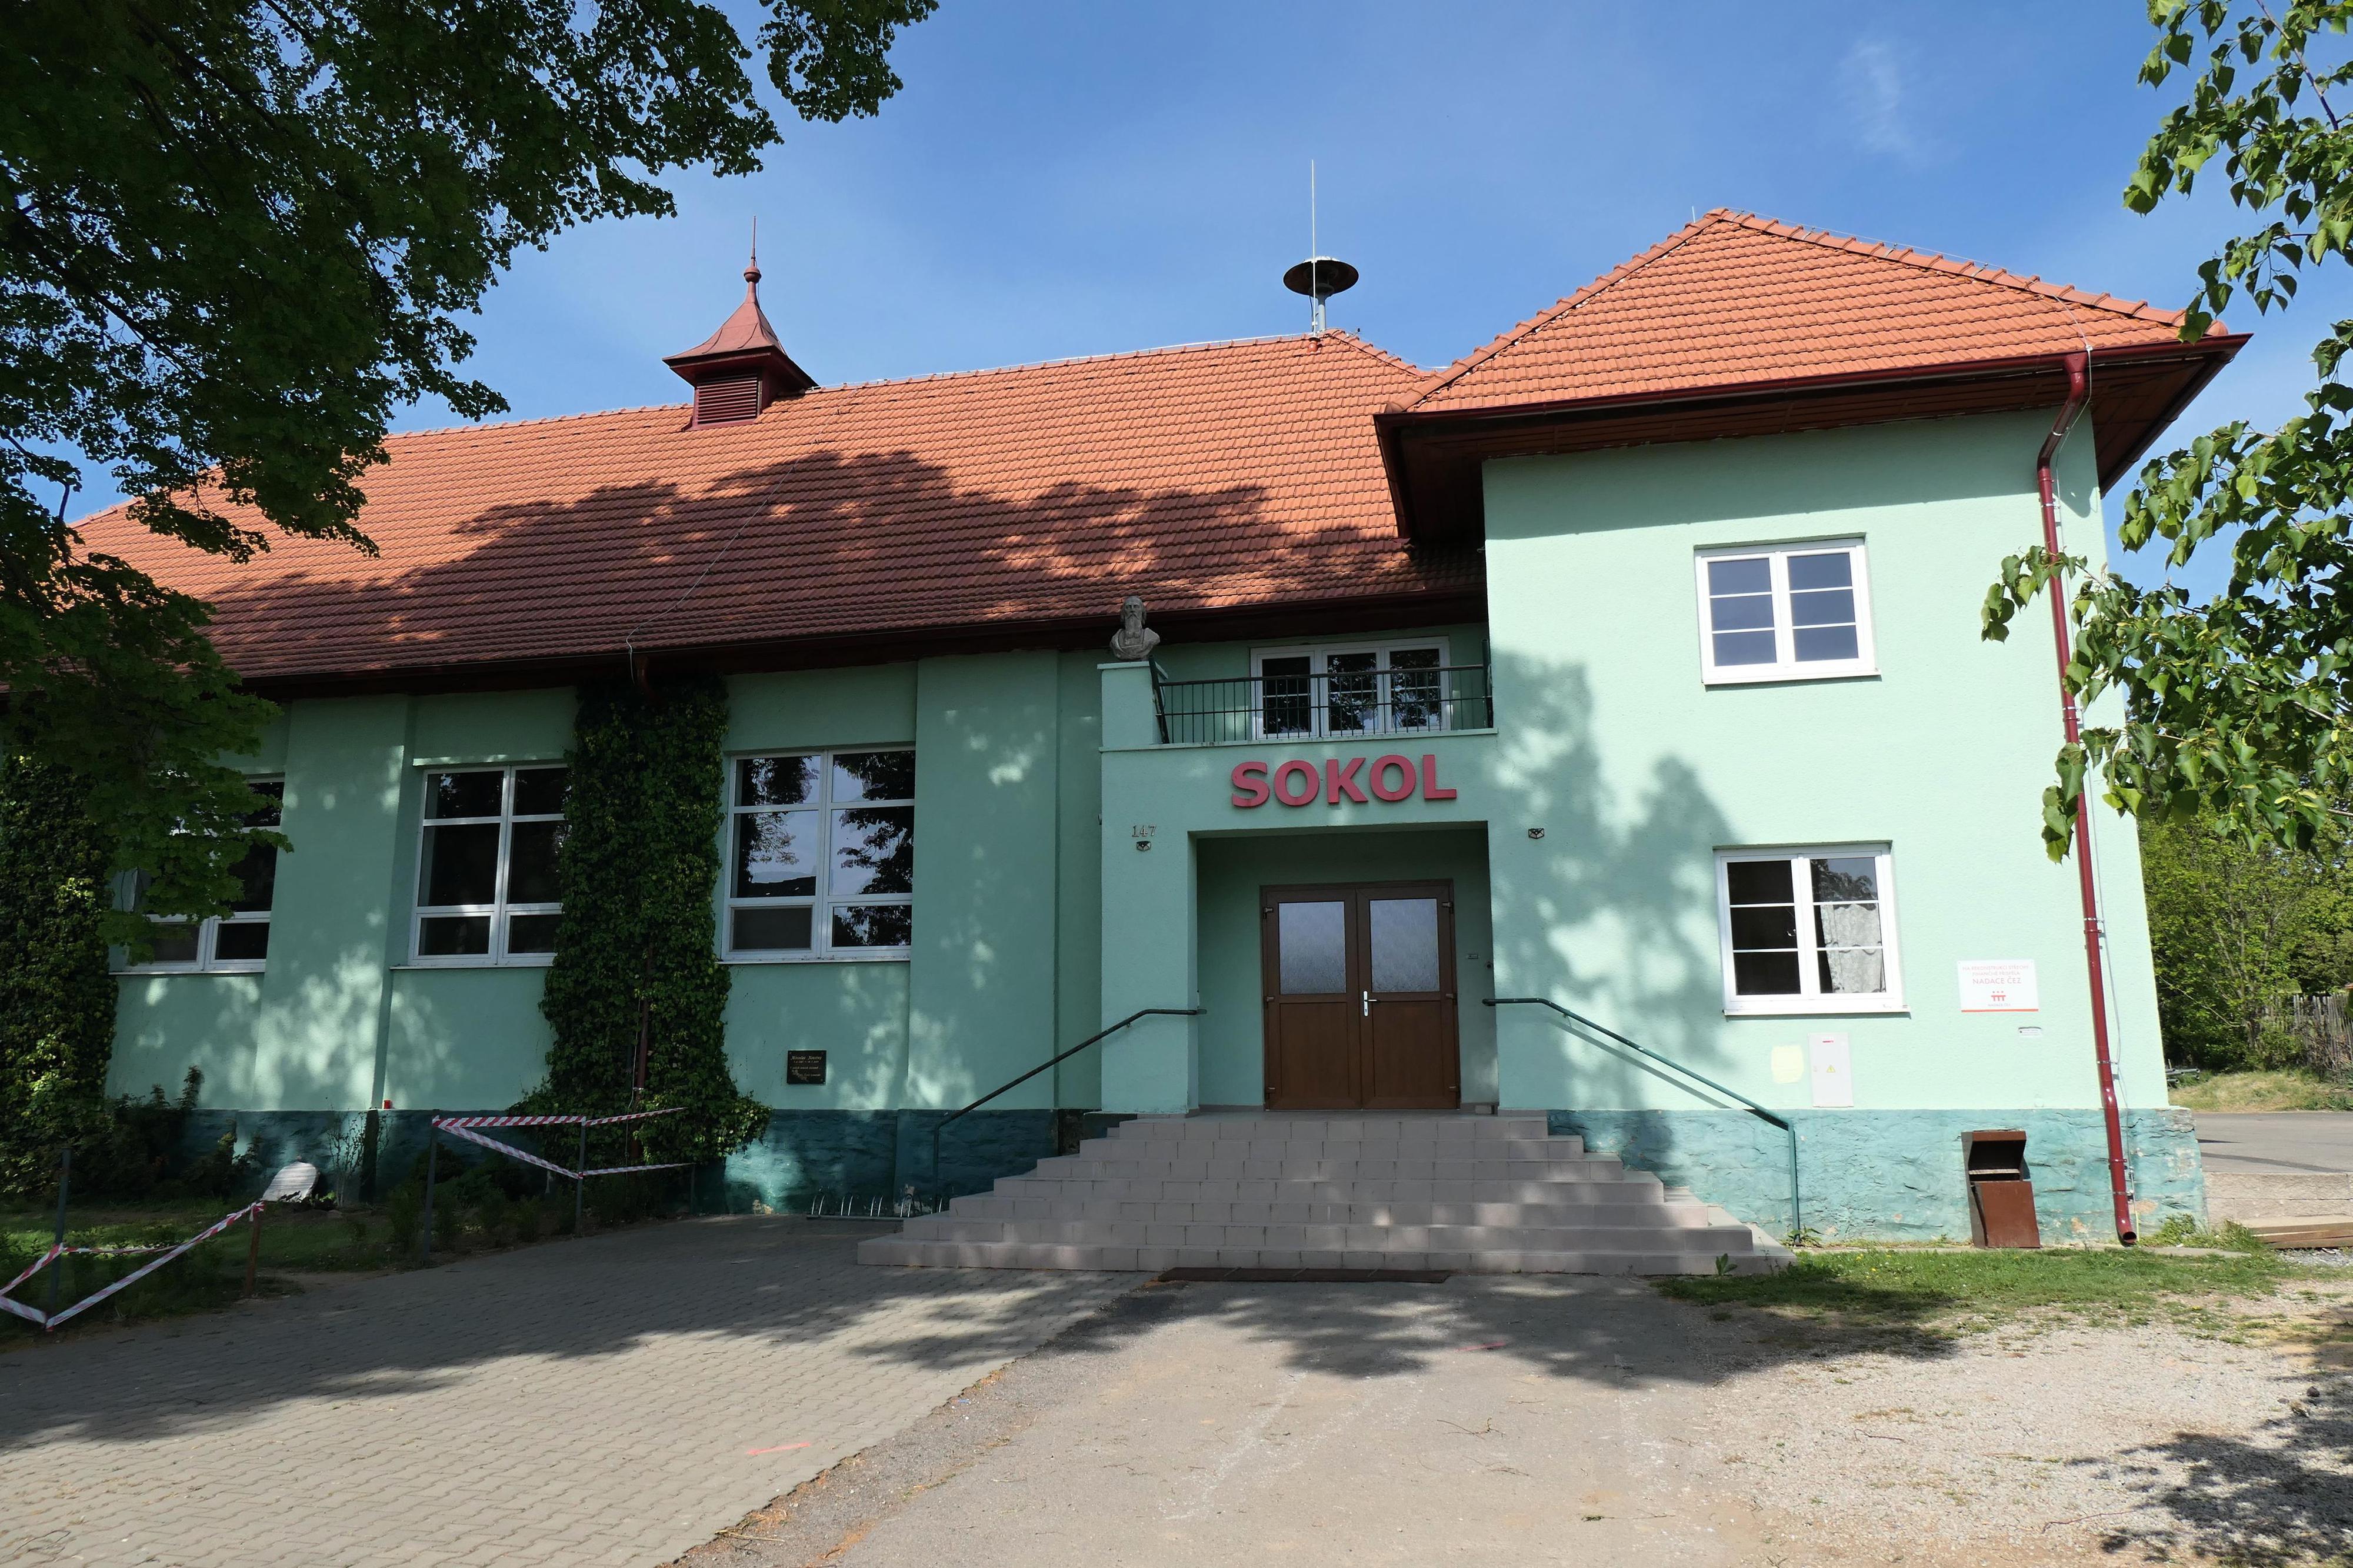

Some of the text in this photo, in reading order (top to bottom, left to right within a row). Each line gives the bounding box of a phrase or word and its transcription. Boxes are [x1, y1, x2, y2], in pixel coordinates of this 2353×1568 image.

[1231, 754, 1457, 808] SOKOL
[1132, 825, 1156, 837] 147
[2007, 976, 2022, 984] ČEZ
